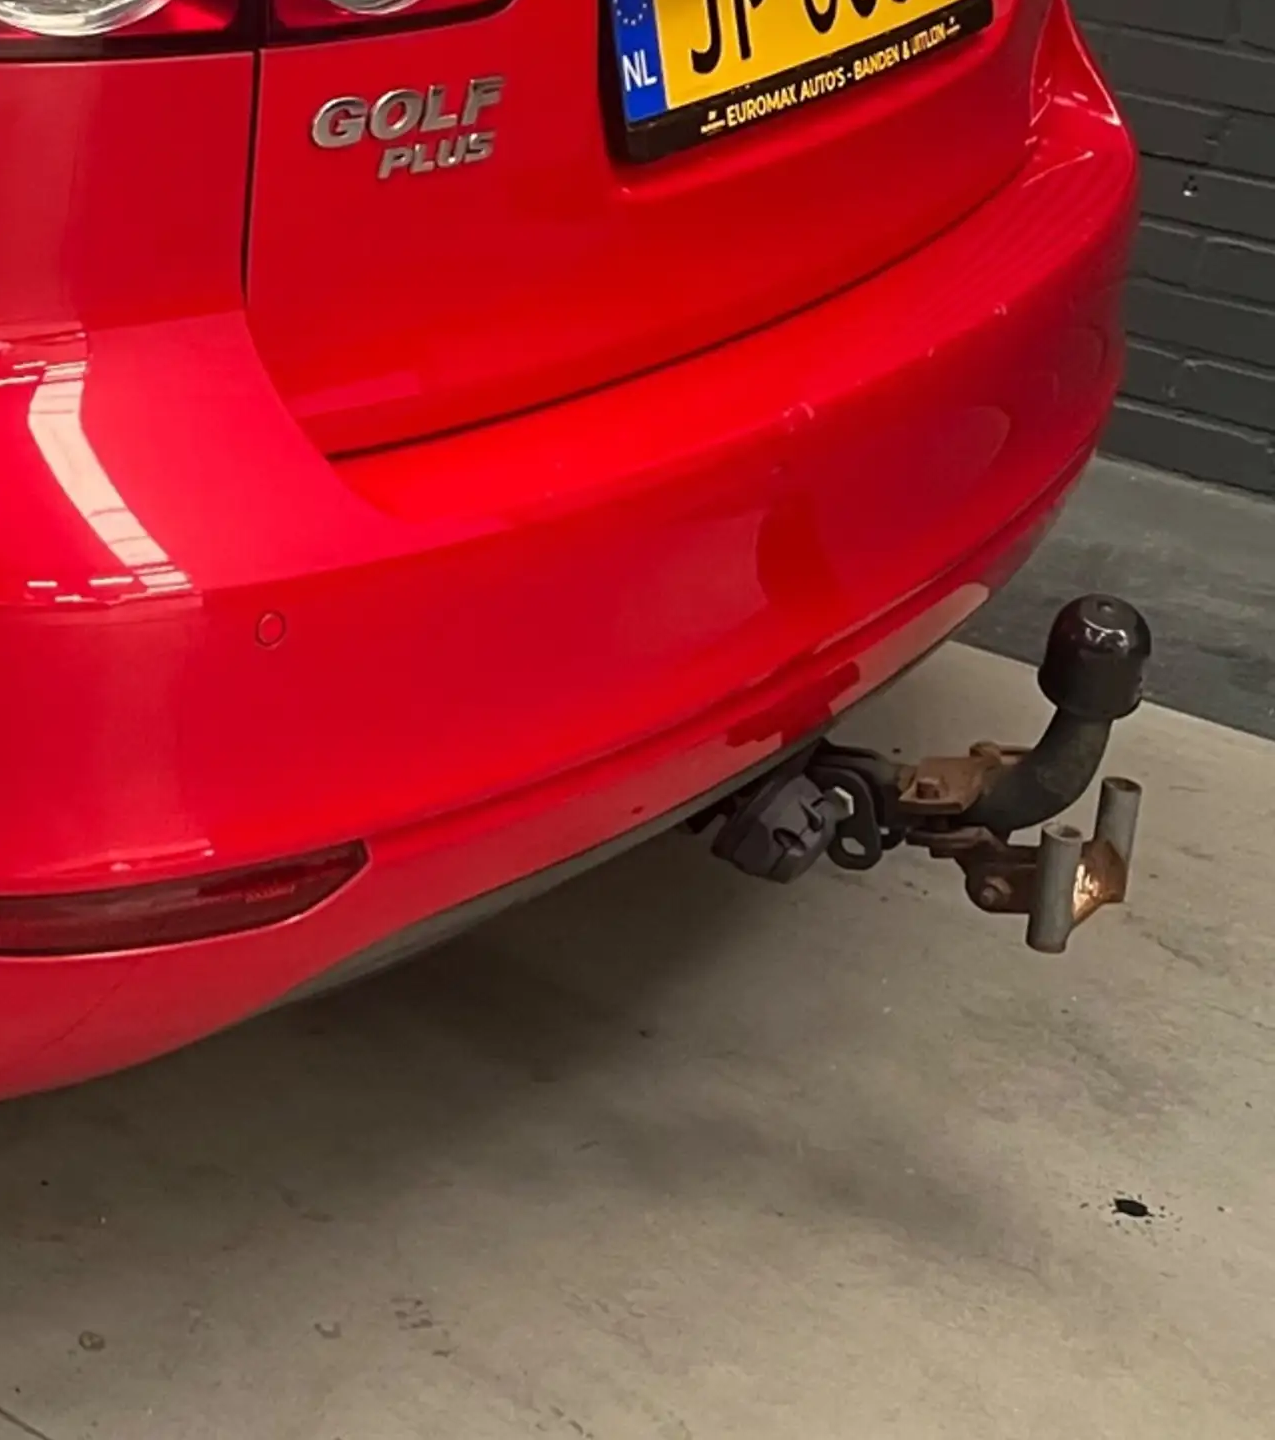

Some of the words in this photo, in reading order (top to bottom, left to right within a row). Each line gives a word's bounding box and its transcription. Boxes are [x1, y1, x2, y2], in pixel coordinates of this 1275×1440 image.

[622, 49, 657, 93] NL
[726, 84, 797, 127] EUROMAX
[800, 66, 846, 101] AUTO'S
[854, 43, 900, 81] BANDEN
[312, 75, 505, 149] GOLF
[377, 131, 496, 179] PLUS
